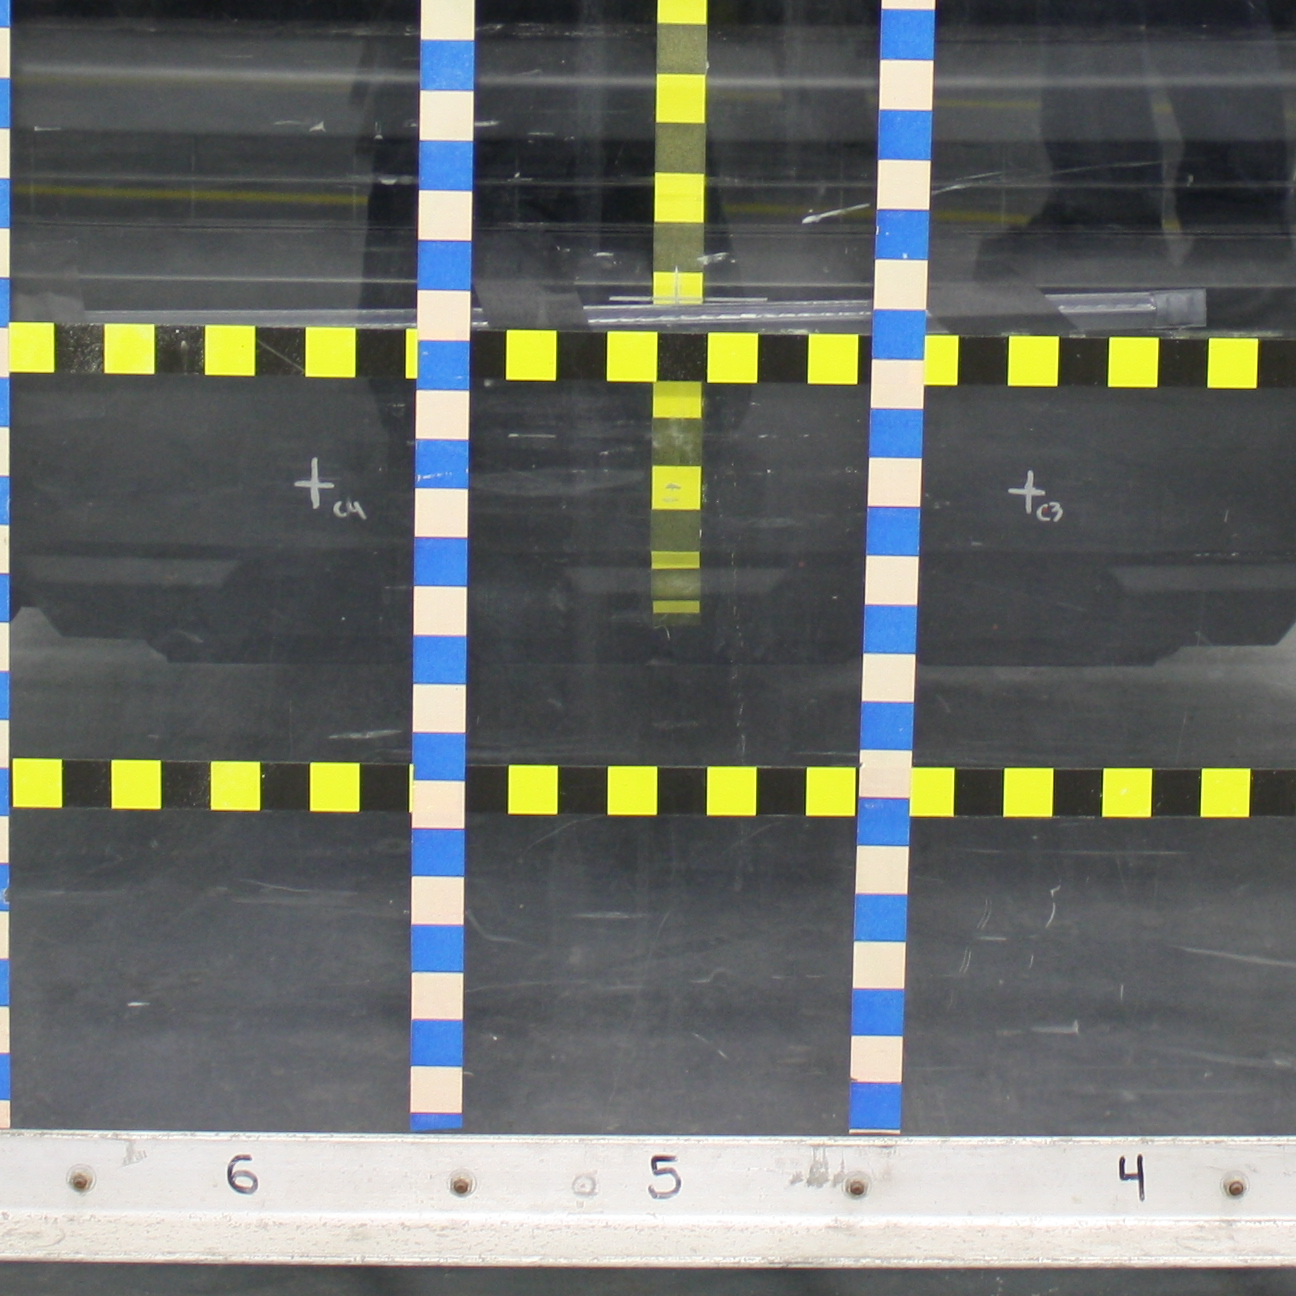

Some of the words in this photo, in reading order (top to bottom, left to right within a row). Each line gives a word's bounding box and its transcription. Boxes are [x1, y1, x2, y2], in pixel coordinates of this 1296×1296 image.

[1036, 501, 1064, 523] C3
[226, 1154, 259, 1195] 6
[647, 1155, 682, 1200] 5
[1118, 1155, 1147, 1201] 4
